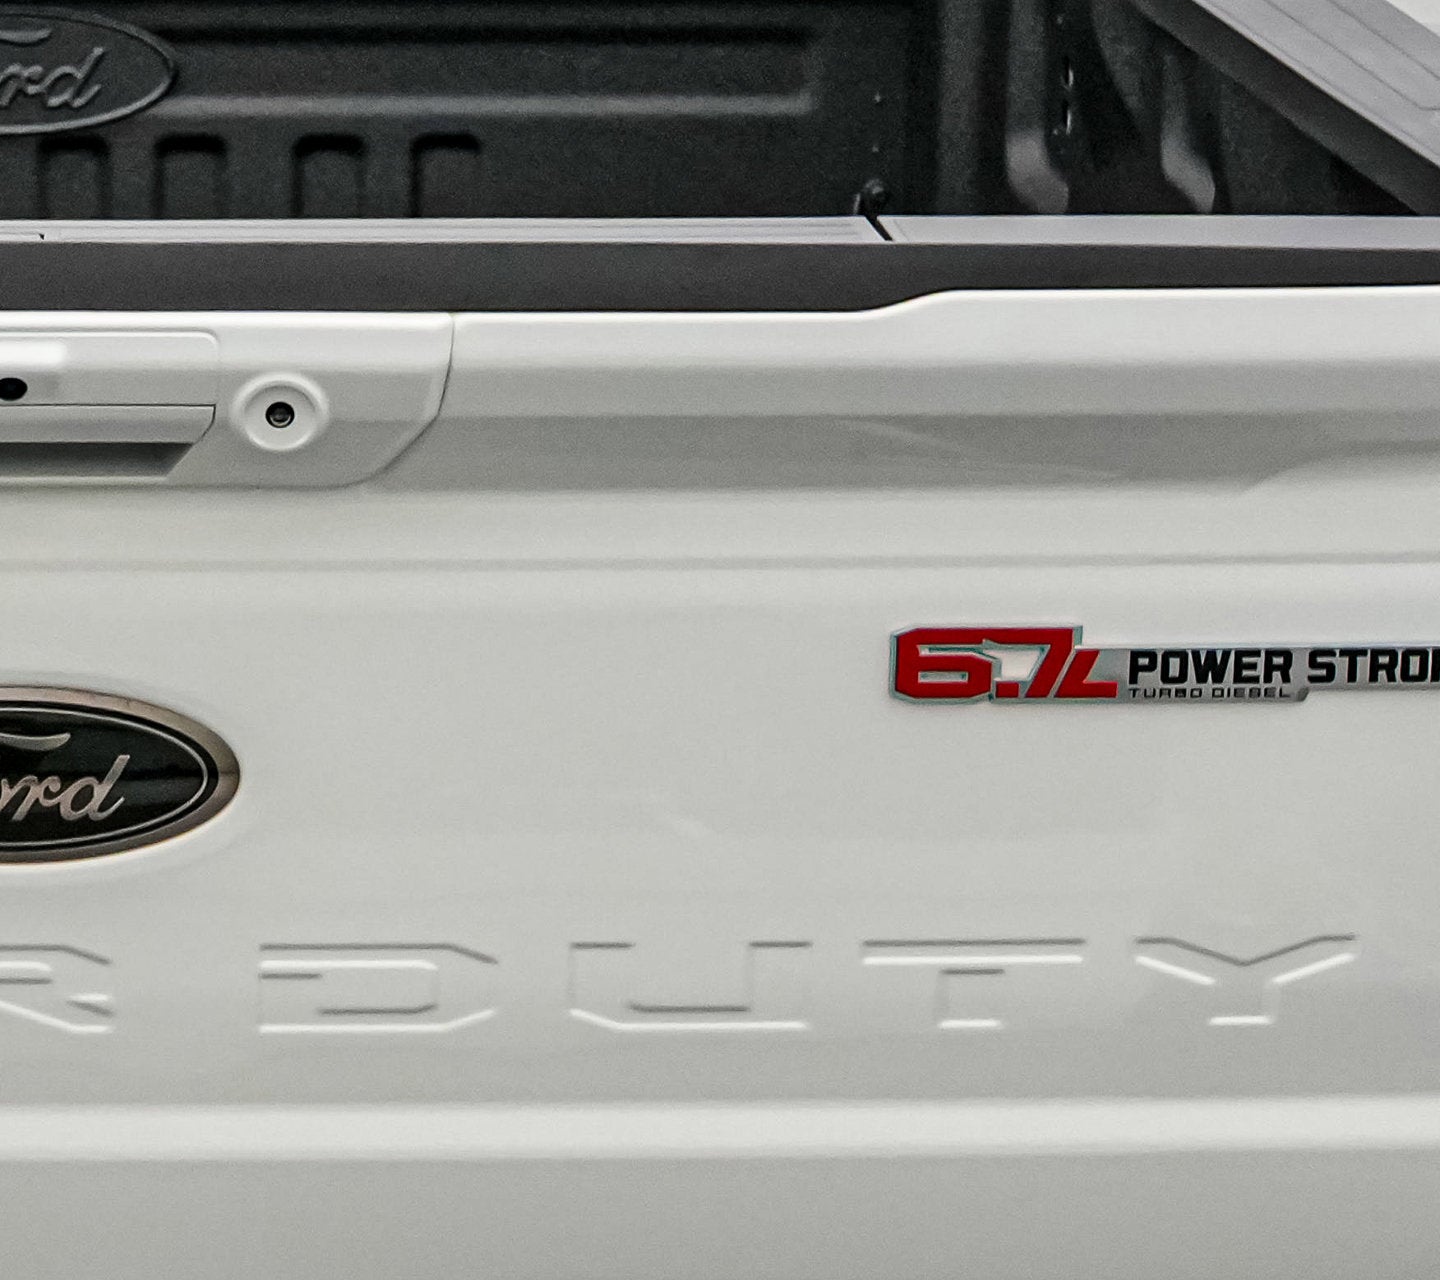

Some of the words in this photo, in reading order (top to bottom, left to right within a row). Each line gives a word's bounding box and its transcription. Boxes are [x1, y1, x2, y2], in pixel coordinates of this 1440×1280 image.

[894, 627, 1118, 700] 6.7L
[1128, 649, 1294, 685] POWER
[1128, 687, 1202, 699] TURBO
[1211, 686, 1291, 699] DIESEL
[258, 933, 1357, 1035] DUTY
